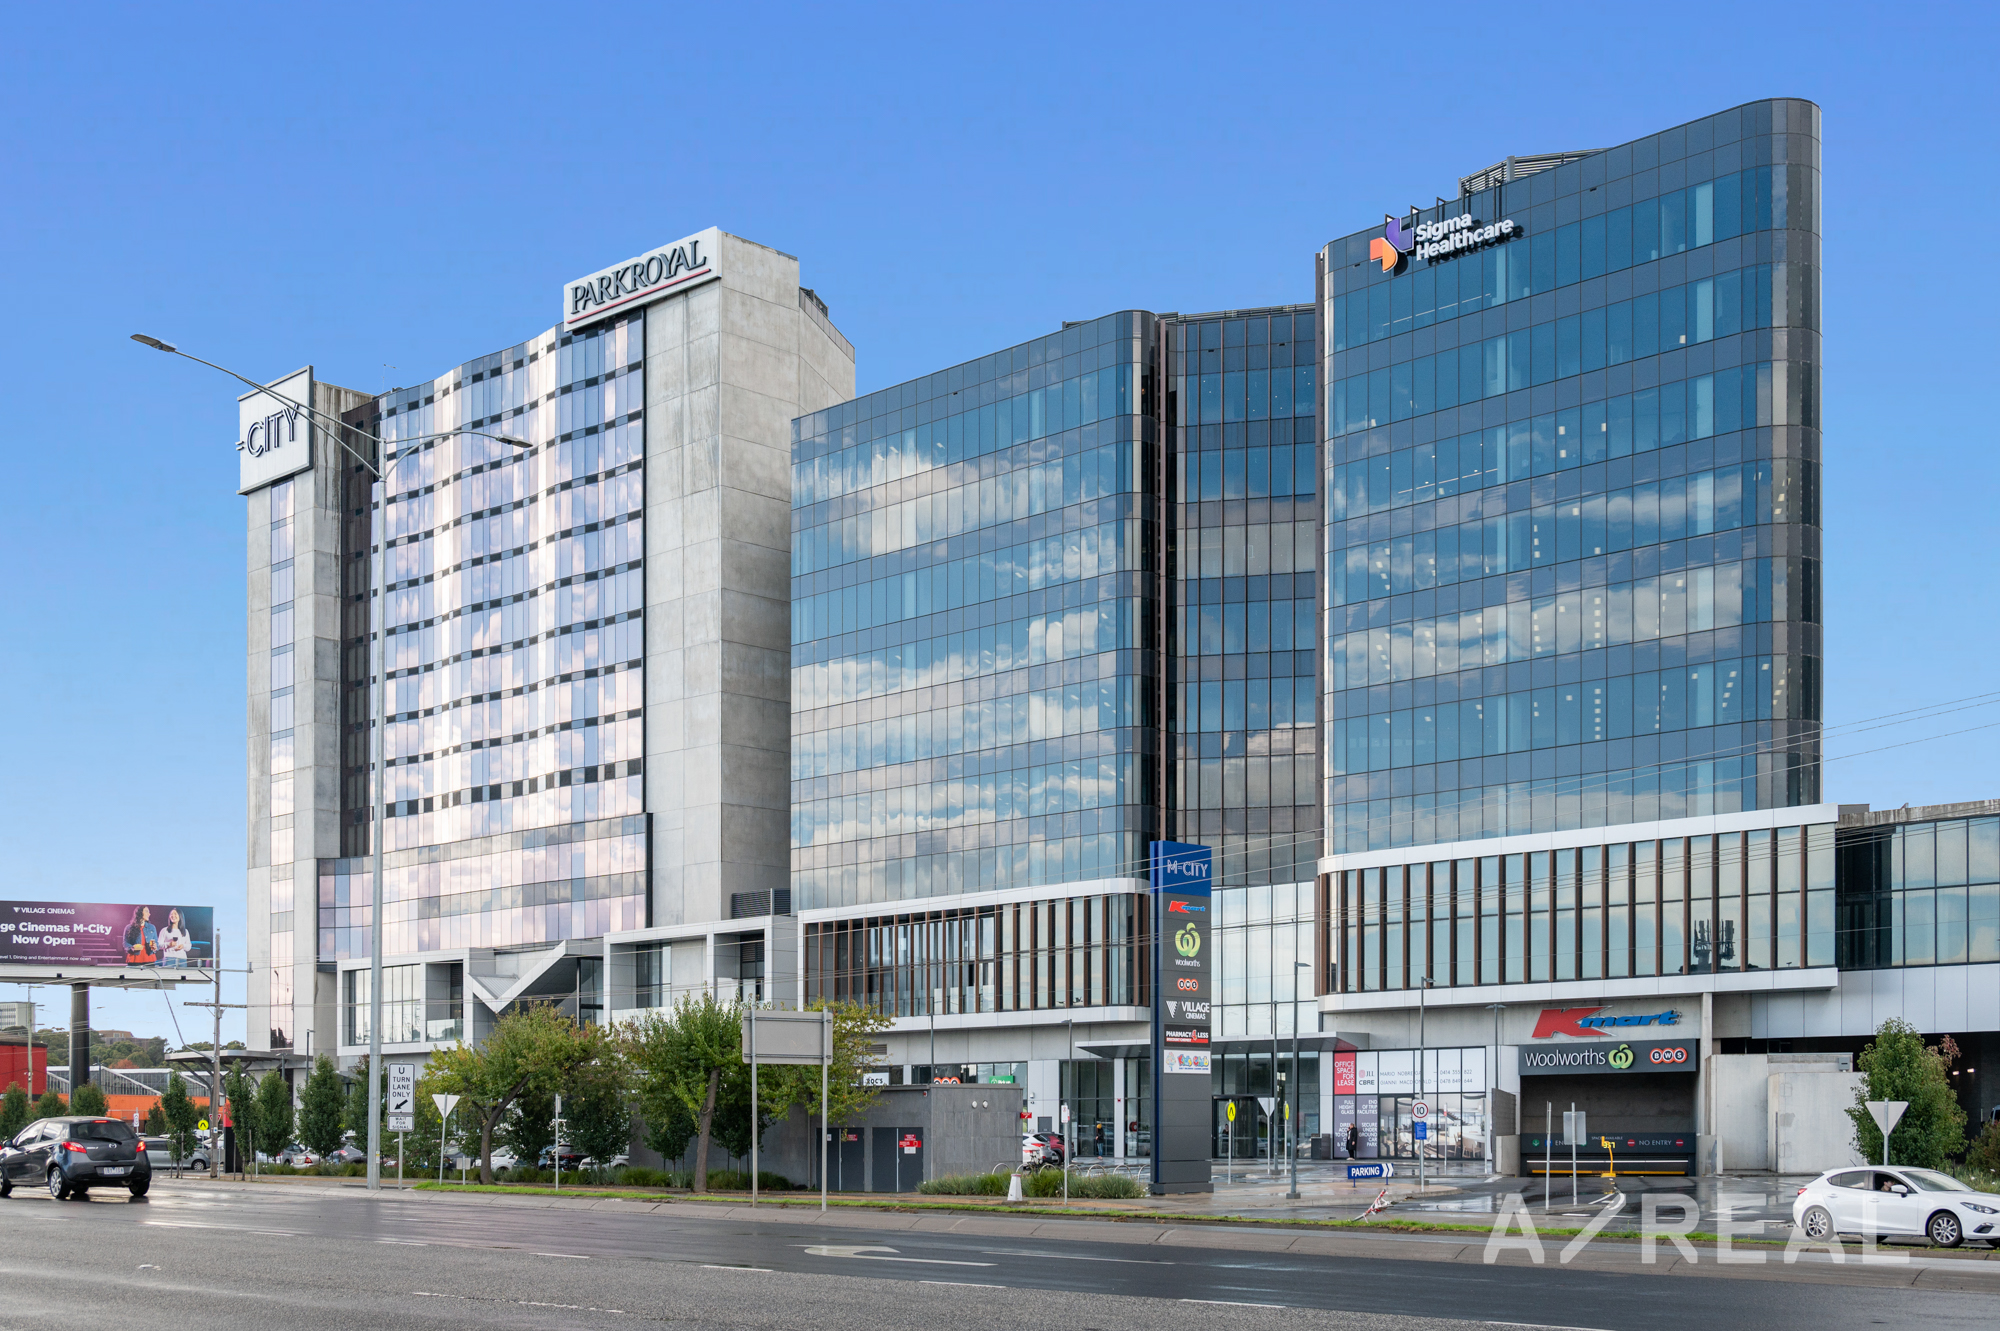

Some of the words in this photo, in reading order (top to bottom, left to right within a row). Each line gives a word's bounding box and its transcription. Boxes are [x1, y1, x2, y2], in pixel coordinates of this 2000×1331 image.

[1416, 213, 1472, 241] Sigma
[1416, 219, 1514, 261] Healthcare
[570, 240, 707, 315] PARKROYAL
[47, 907, 75, 915] CINEMAS
[1168, 900, 1206, 914] Kmart
[18, 922, 70, 933] Cinemas
[73, 923, 112, 935] M-City
[12, 934, 40, 944] Now
[42, 935, 76, 947] Open
[1174, 958, 1201, 967] Woolworths
[1181, 1001, 1210, 1012] VILLAGE
[1531, 1005, 1684, 1039] Kmart
[1192, 1029, 1198, 1040] 4
[1525, 1048, 1606, 1067] Woolworths
[1652, 1049, 1685, 1062] BWS
[1351, 1166, 1380, 1176] PARKING
